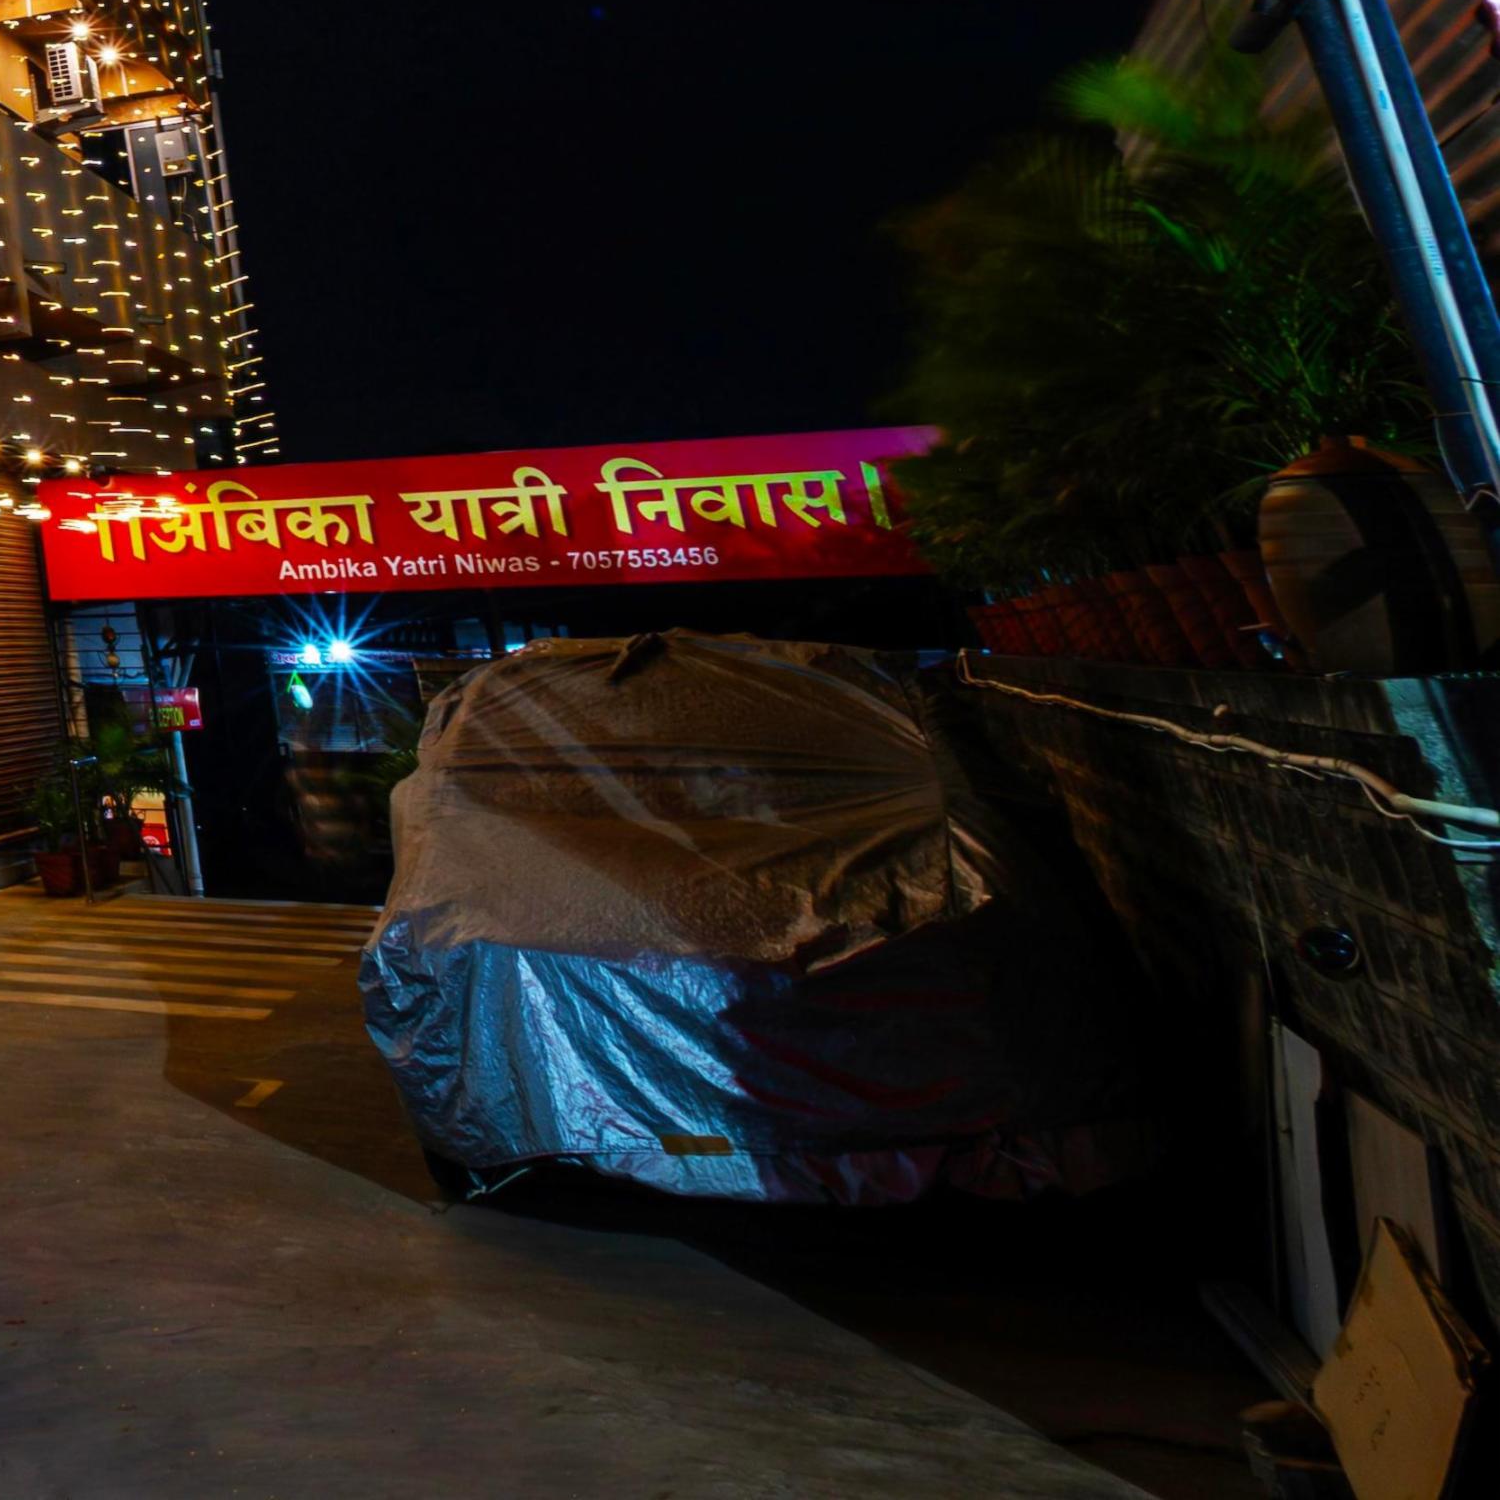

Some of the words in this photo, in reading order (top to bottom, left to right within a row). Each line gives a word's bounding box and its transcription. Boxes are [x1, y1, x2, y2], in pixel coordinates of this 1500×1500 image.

[400, 465, 573, 541] यात्री
[278, 556, 378, 580] Ambika
[383, 554, 446, 576] Yatri
[454, 552, 541, 575] Niwas
[566, 546, 720, 570] 7057553456
